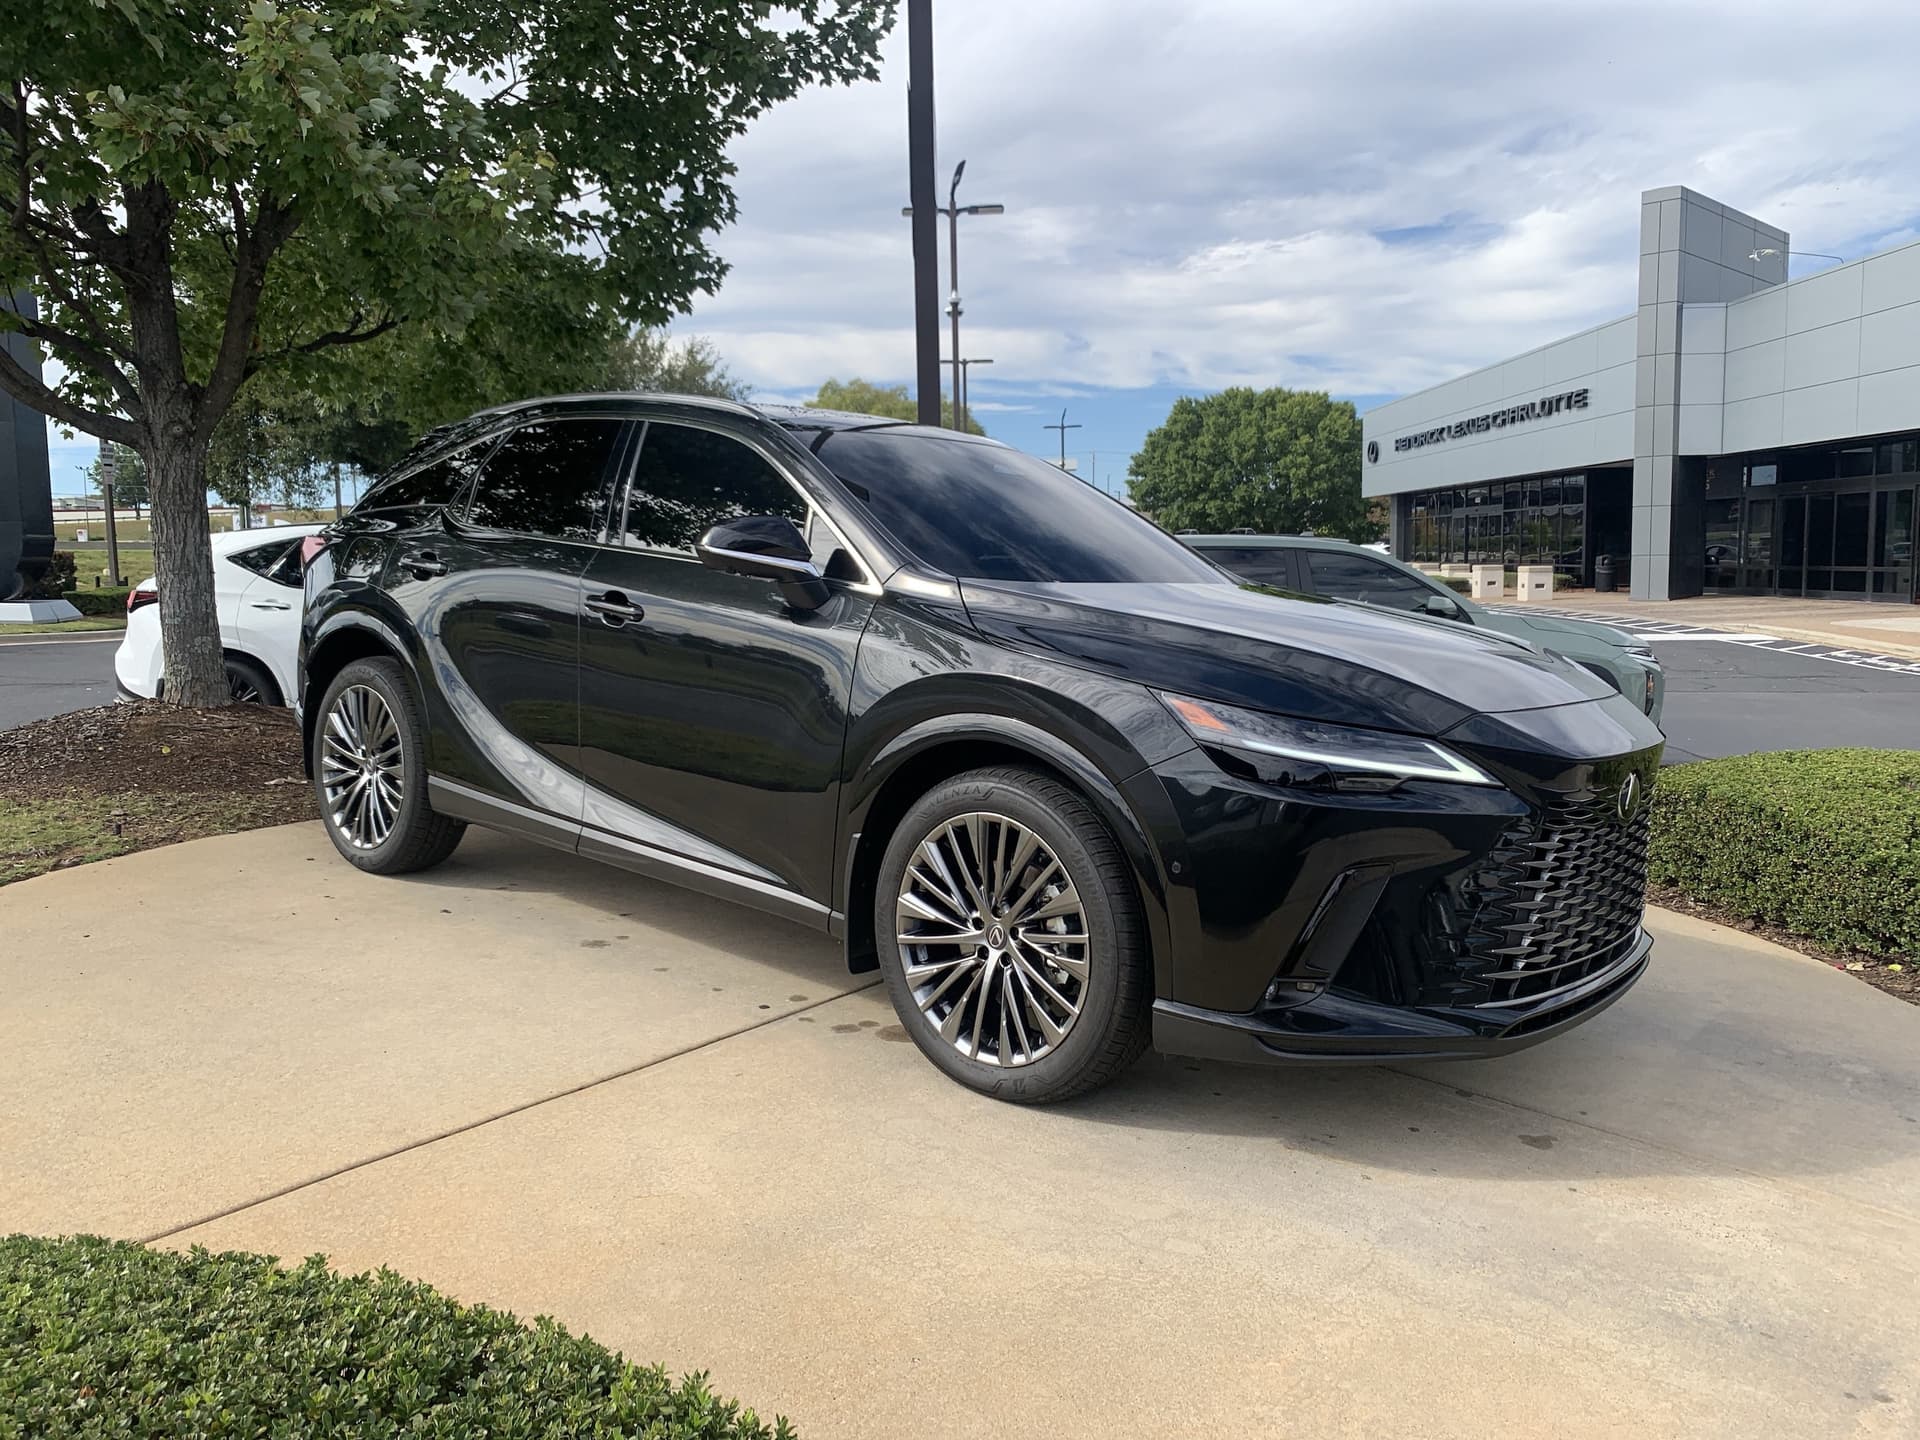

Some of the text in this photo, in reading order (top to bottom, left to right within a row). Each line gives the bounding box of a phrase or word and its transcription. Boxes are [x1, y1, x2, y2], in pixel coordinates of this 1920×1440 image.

[1395, 388, 1589, 452] HENDRICK LEXUS CHARLOTTE
